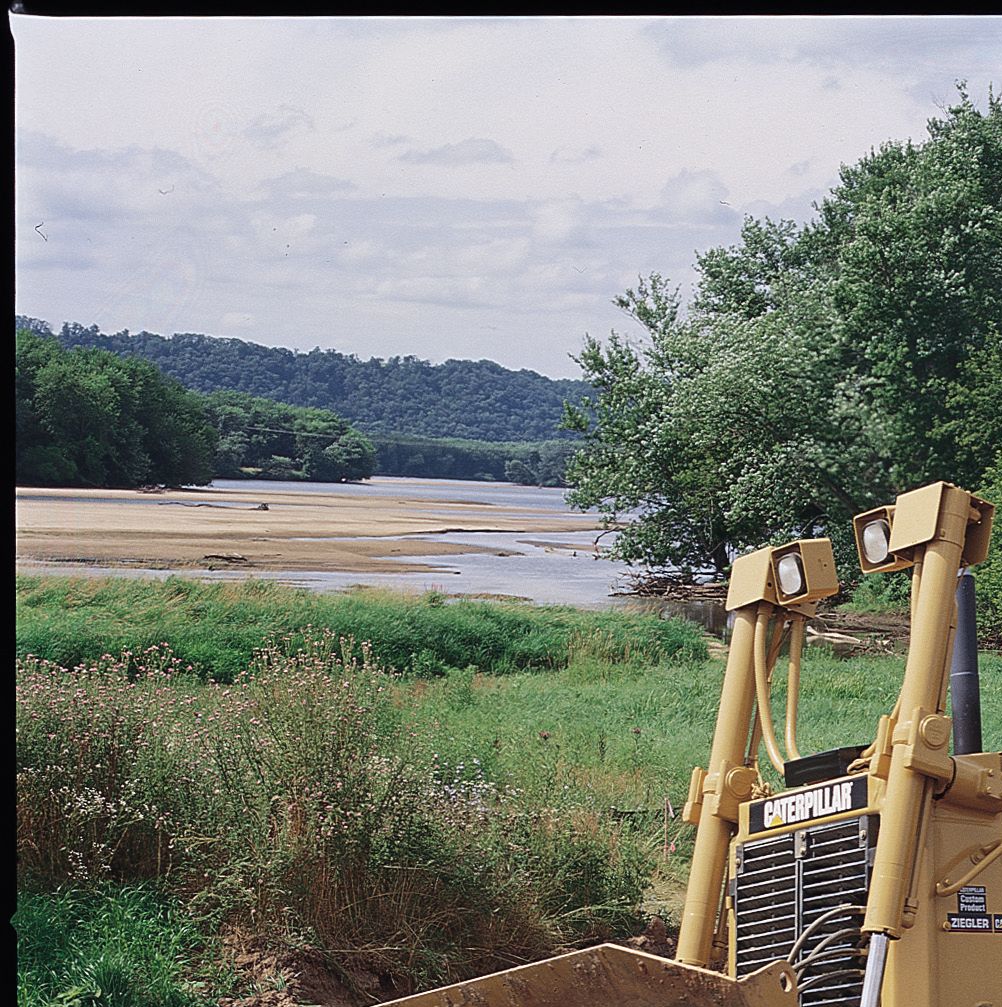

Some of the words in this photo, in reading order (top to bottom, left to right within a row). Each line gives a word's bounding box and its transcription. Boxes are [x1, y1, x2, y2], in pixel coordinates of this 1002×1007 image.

[764, 781, 853, 828] CATERPILLAR
[960, 894, 984, 903] Custom
[960, 903, 986, 912] Product
[951, 917, 989, 929] ZIEGLER
